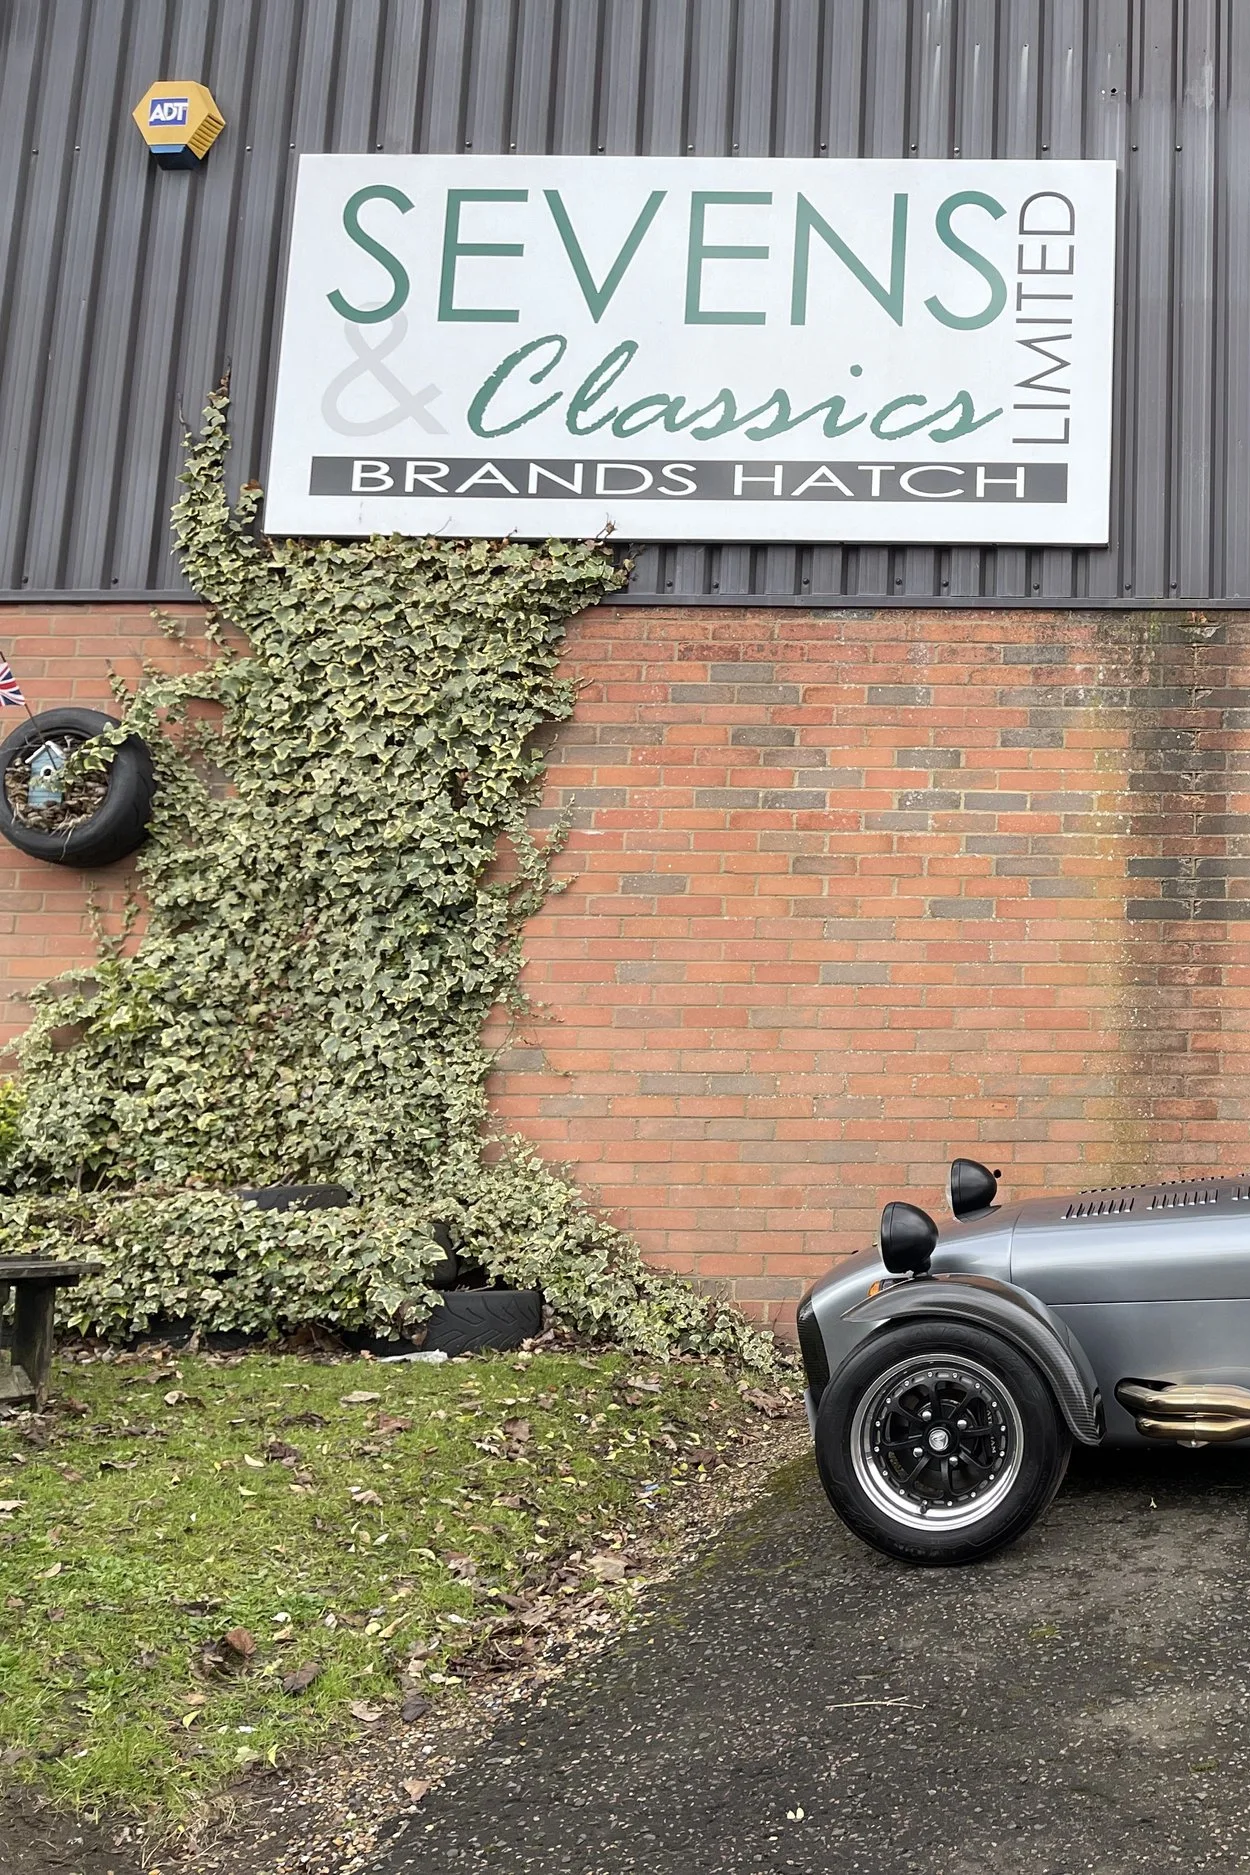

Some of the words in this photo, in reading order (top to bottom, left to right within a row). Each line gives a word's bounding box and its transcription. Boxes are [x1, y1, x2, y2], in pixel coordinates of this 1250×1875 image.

[149, 102, 189, 122] ADT
[327, 185, 1008, 331] SEVENS
[1012, 190, 1076, 445] LIMITED
[321, 301, 449, 437] &
[467, 333, 1004, 443] Classics
[351, 459, 699, 497] BRANDS
[733, 463, 1026, 499] HATCH
